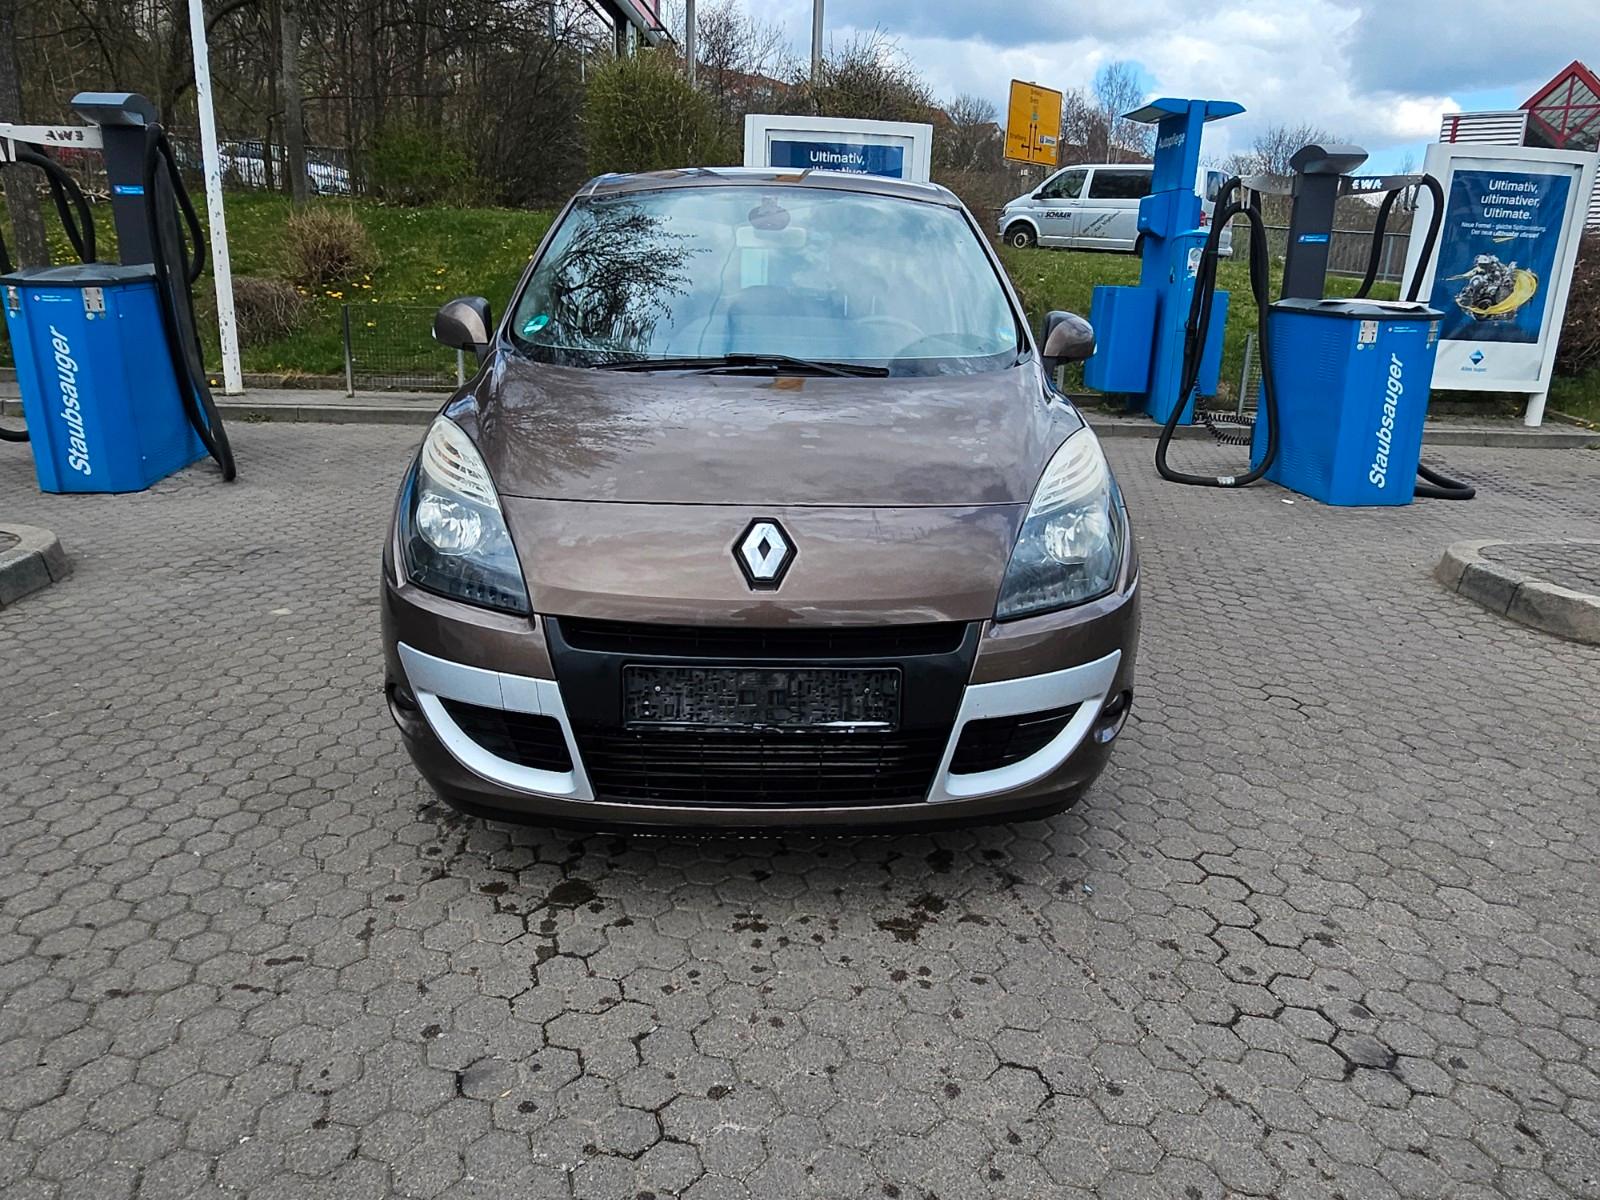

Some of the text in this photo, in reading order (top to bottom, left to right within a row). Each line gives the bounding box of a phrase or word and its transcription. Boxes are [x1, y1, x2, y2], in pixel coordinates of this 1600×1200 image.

[810, 150, 865, 166] Ultimativ,
[1352, 178, 1383, 190] EWA
[1488, 179, 1538, 194] Ultimativ,
[1481, 194, 1540, 208] ultimativer,
[1483, 207, 1532, 220] Ultimate.
[49, 325, 92, 476] Staubsauger
[1369, 352, 1405, 489] Staubsauger
